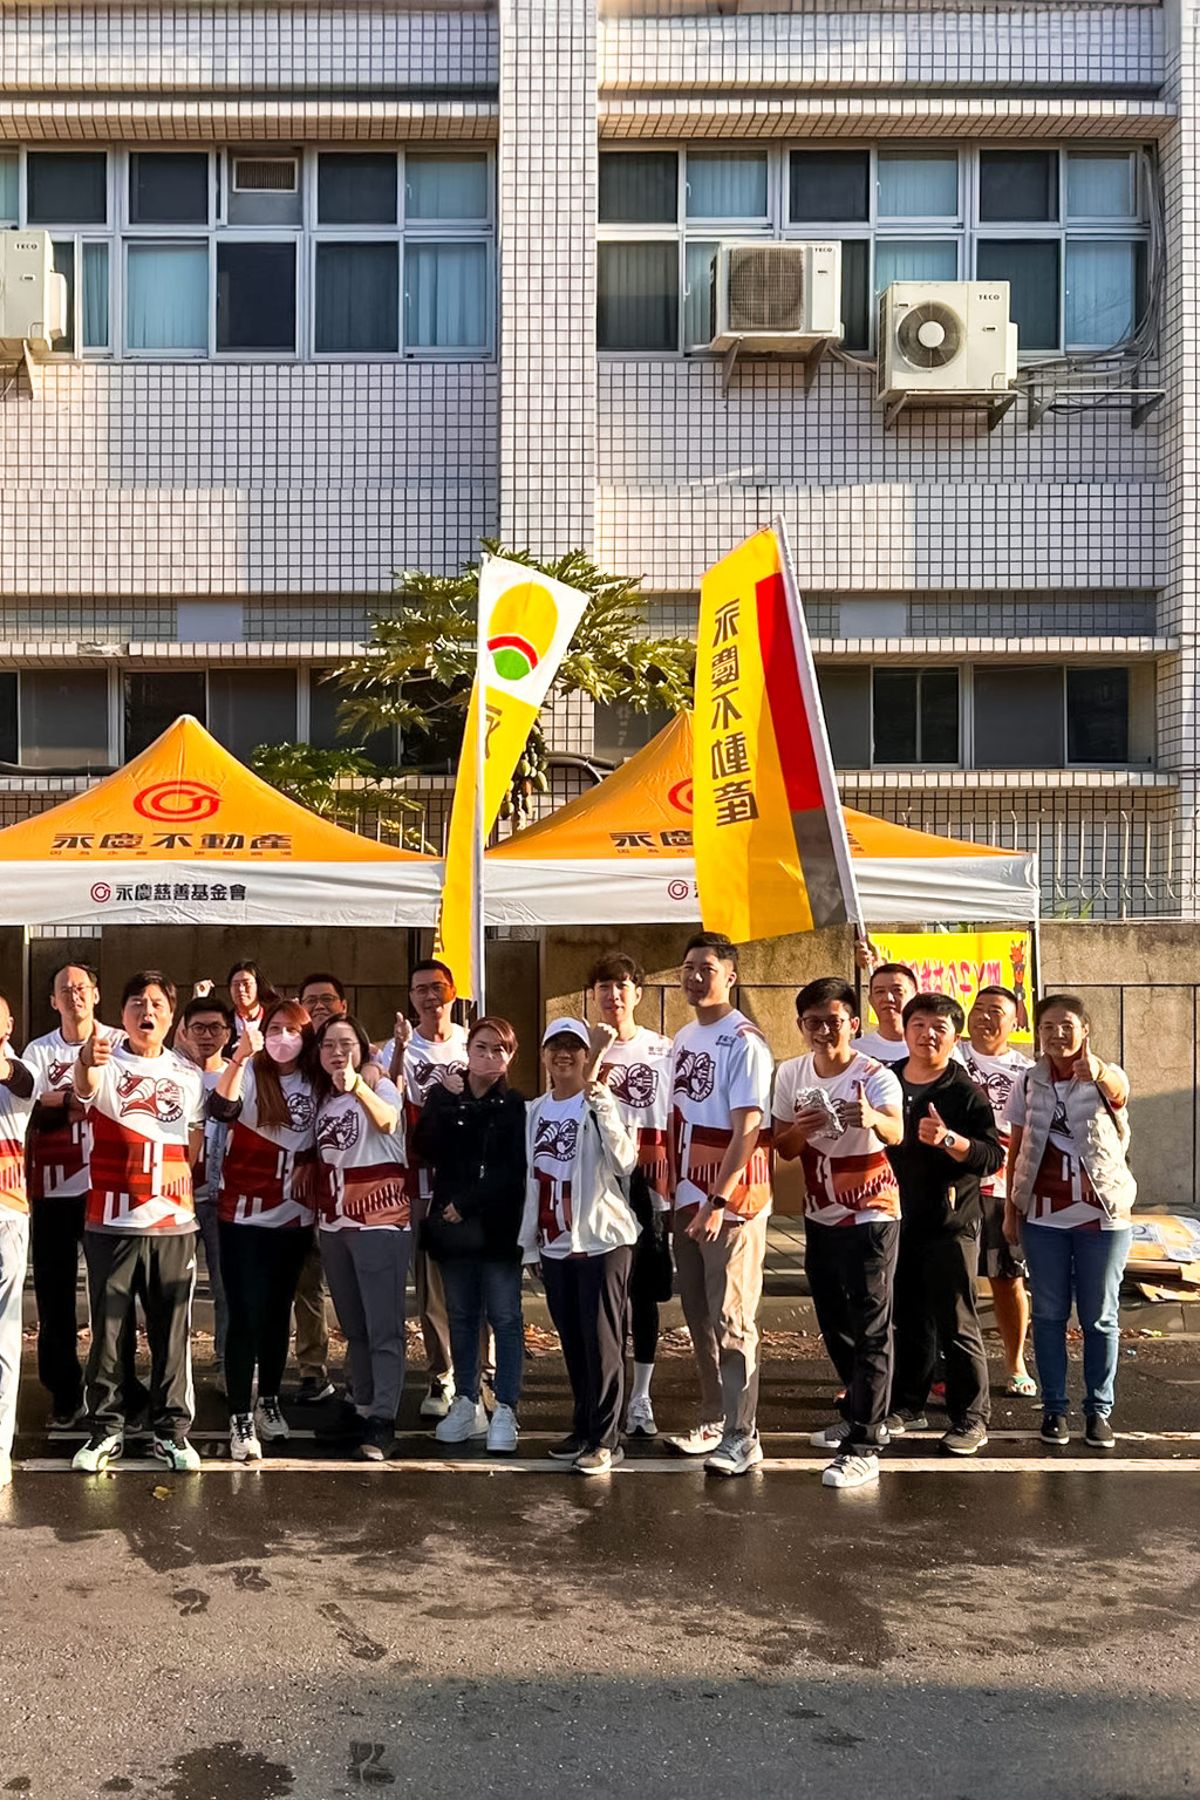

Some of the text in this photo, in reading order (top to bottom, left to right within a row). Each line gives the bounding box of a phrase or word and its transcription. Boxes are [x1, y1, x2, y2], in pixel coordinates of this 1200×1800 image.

[51, 832, 293, 849] 永慶不動產
[115, 883, 246, 901] 永慶慈善基金會
